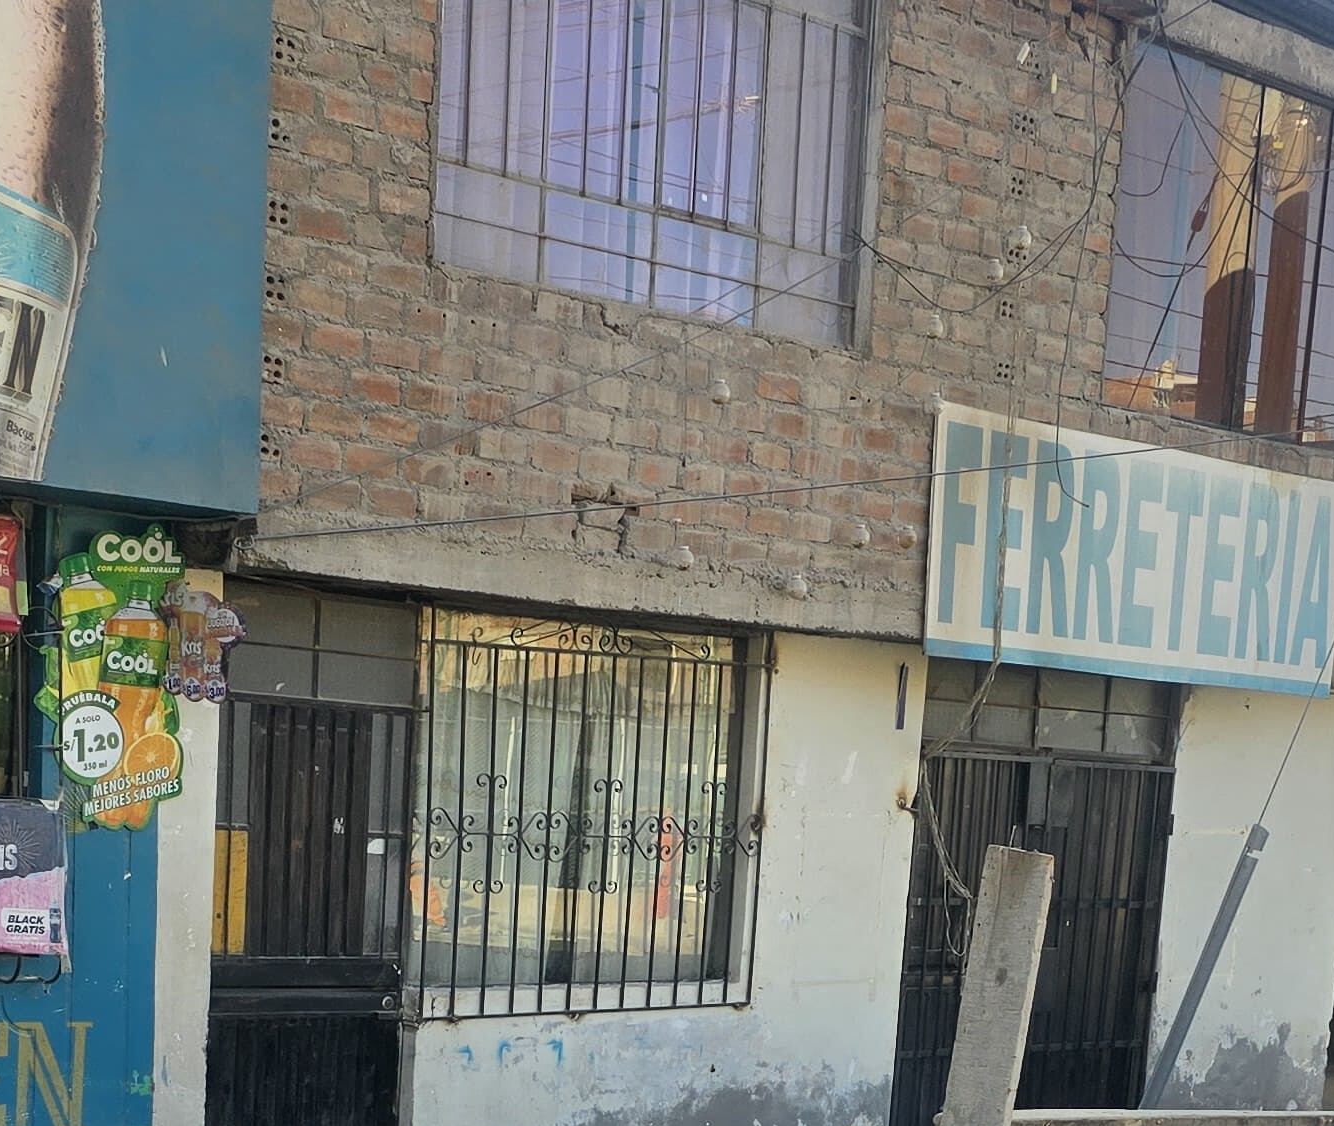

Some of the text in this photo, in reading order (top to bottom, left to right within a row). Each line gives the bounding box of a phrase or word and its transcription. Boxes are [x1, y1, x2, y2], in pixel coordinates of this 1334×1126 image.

[97, 531, 182, 563] COOL
[937, 420, 1333, 669] FERRETERIA
[139, 566, 181, 574] NATURALES
[69, 622, 105, 647] COO
[107, 651, 158, 675] COOL
[75, 715, 101, 725] A SOLO
[83, 760, 108, 771] 350 ml
[92, 766, 170, 798] MENOS FLORO
[84, 779, 180, 817] MEJORES SABORES
[6, 924, 46, 935] GRATIS
[7, 914, 45, 925] BLACK
